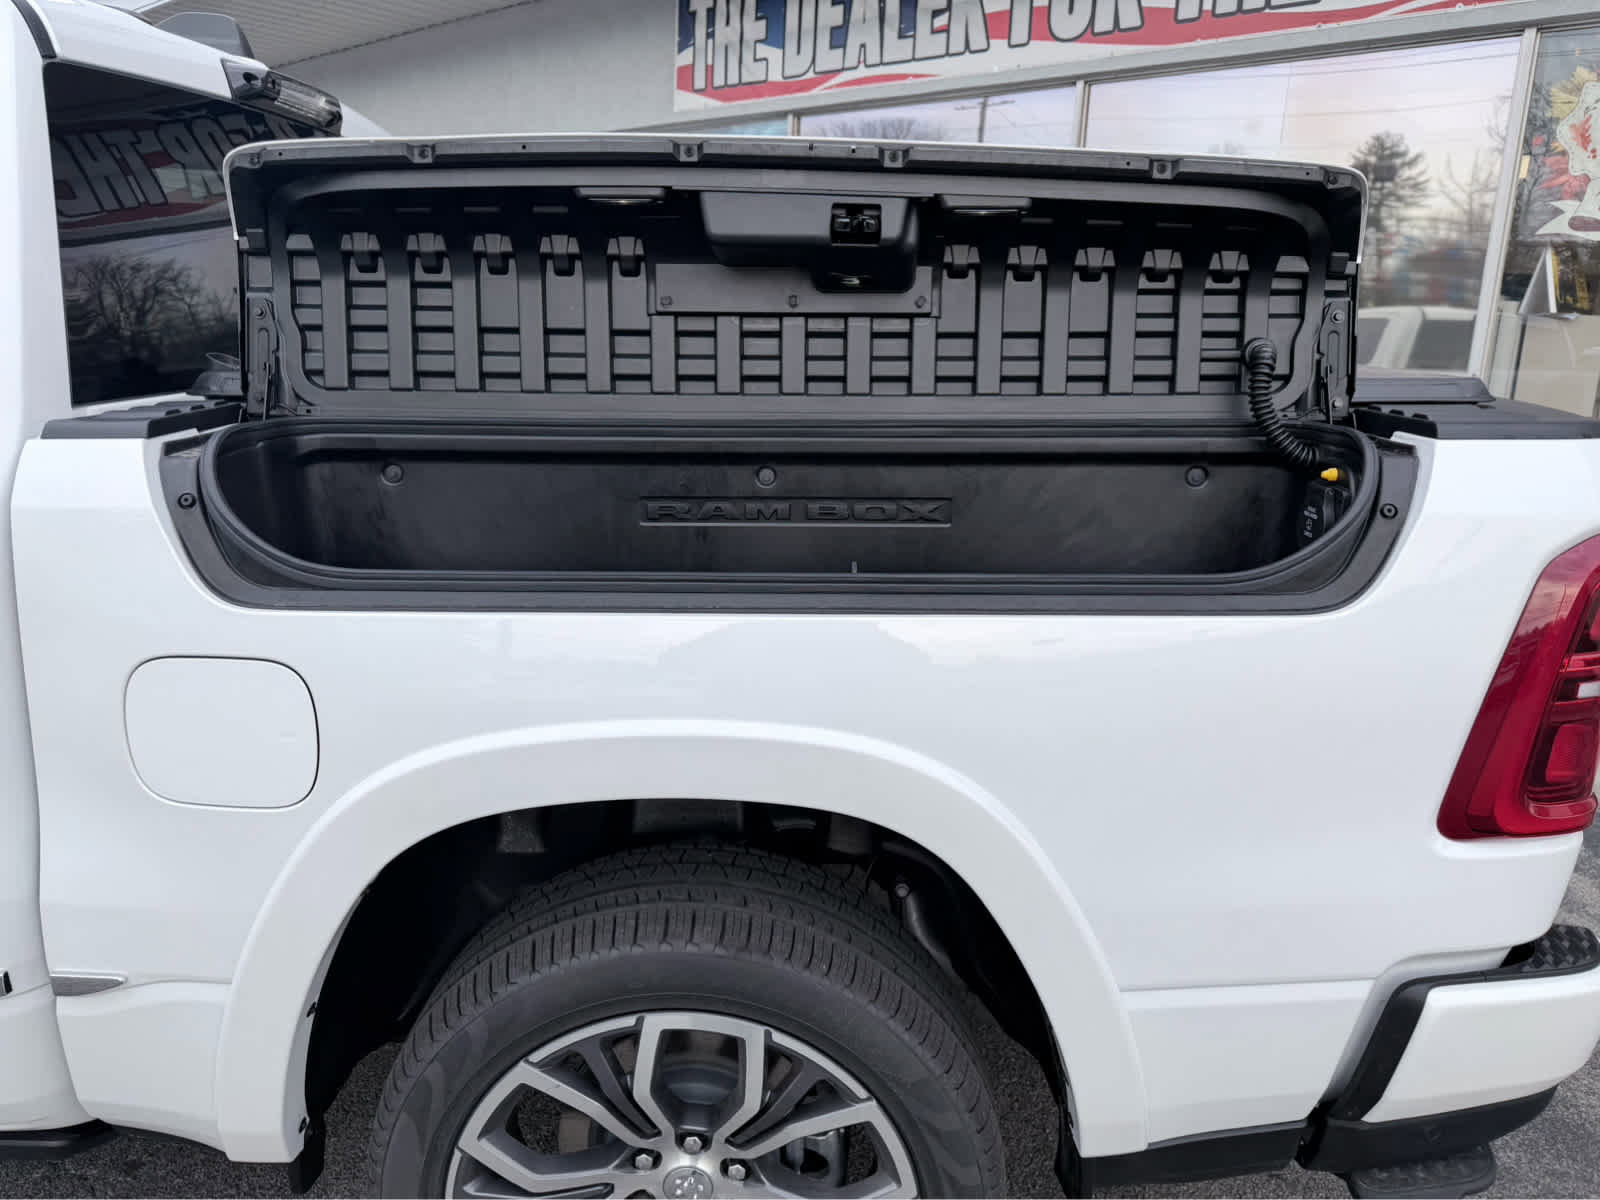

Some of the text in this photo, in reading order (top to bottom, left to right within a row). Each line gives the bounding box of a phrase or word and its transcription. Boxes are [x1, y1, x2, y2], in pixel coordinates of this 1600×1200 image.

[688, 0, 768, 92] THE
[646, 502, 946, 522] RAM BOX
